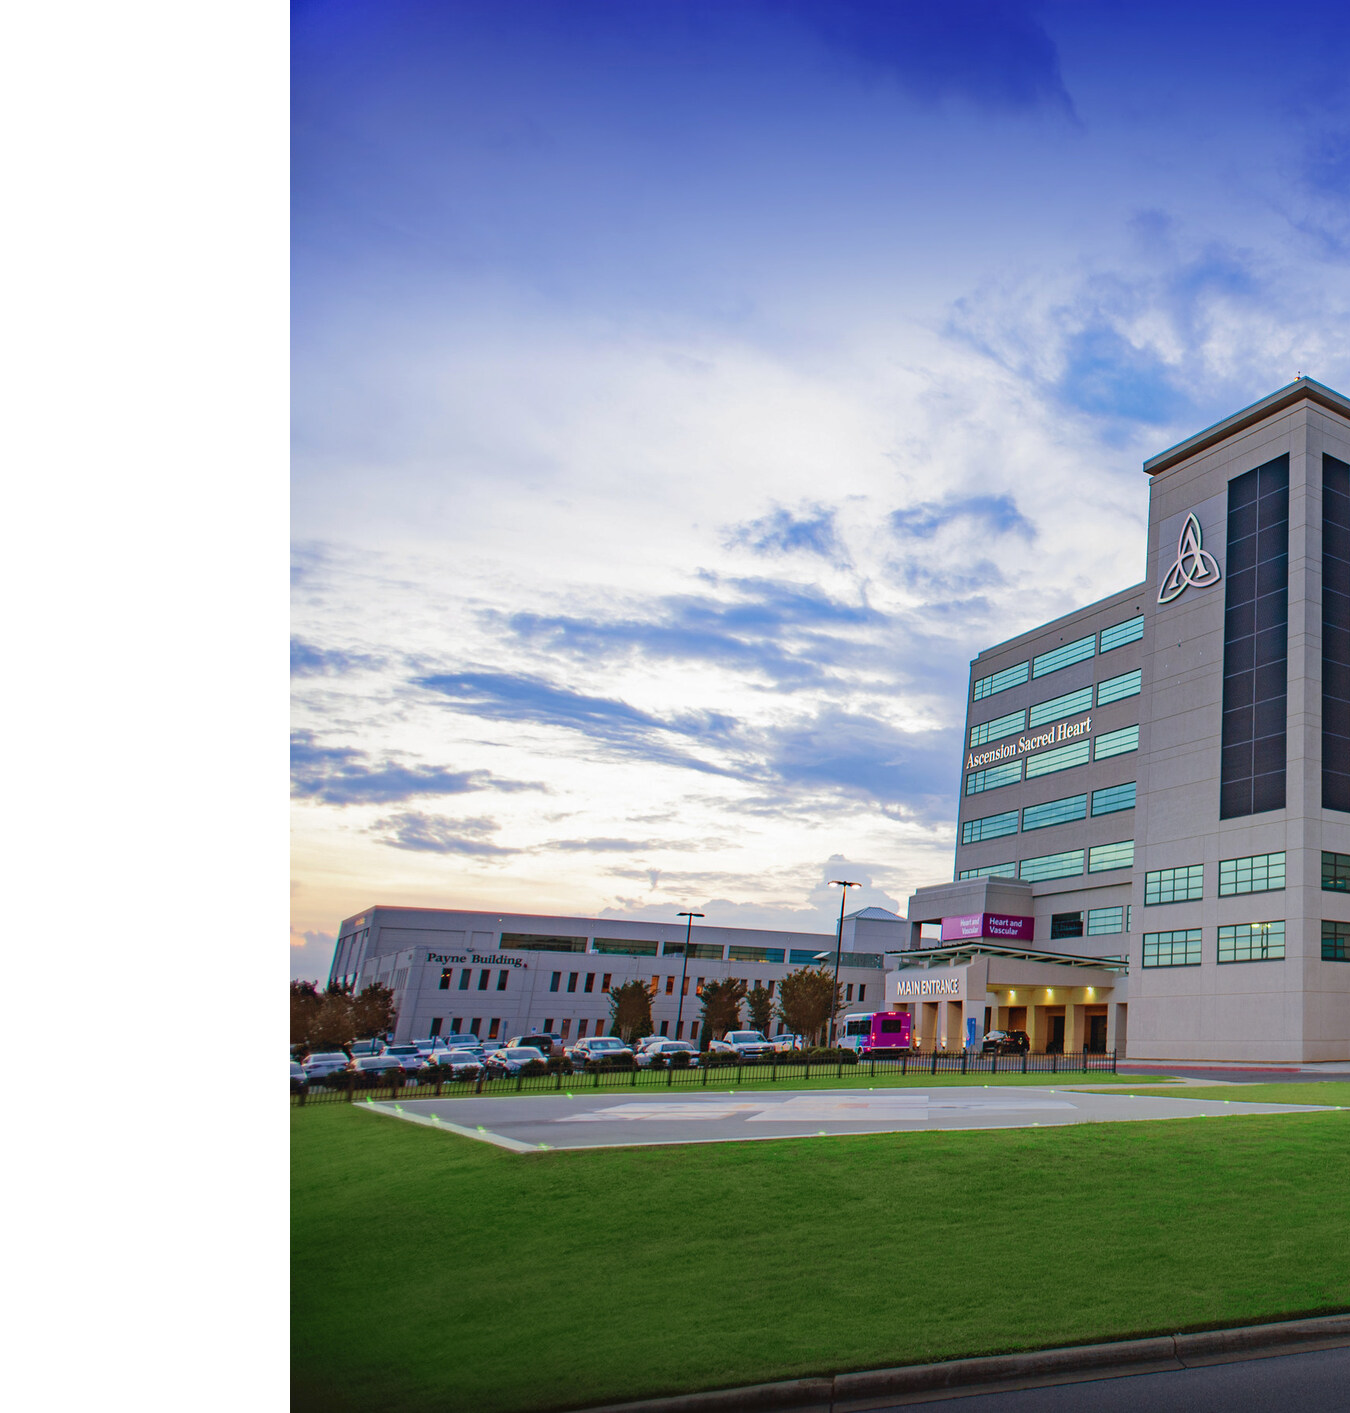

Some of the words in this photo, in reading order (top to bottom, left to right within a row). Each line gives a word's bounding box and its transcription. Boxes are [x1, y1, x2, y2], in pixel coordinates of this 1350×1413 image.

[966, 744, 1016, 769] Ascension
[1018, 726, 1055, 754] Sacred
[1056, 716, 1092, 742] Heart
[989, 917, 1008, 926] Heart
[1009, 919, 1022, 927] and
[989, 926, 1018, 935] Vascular
[427, 952, 467, 965] Payne
[471, 954, 523, 968] Building
[897, 980, 920, 995] MAIN
[921, 979, 959, 994] ENTRANCE
